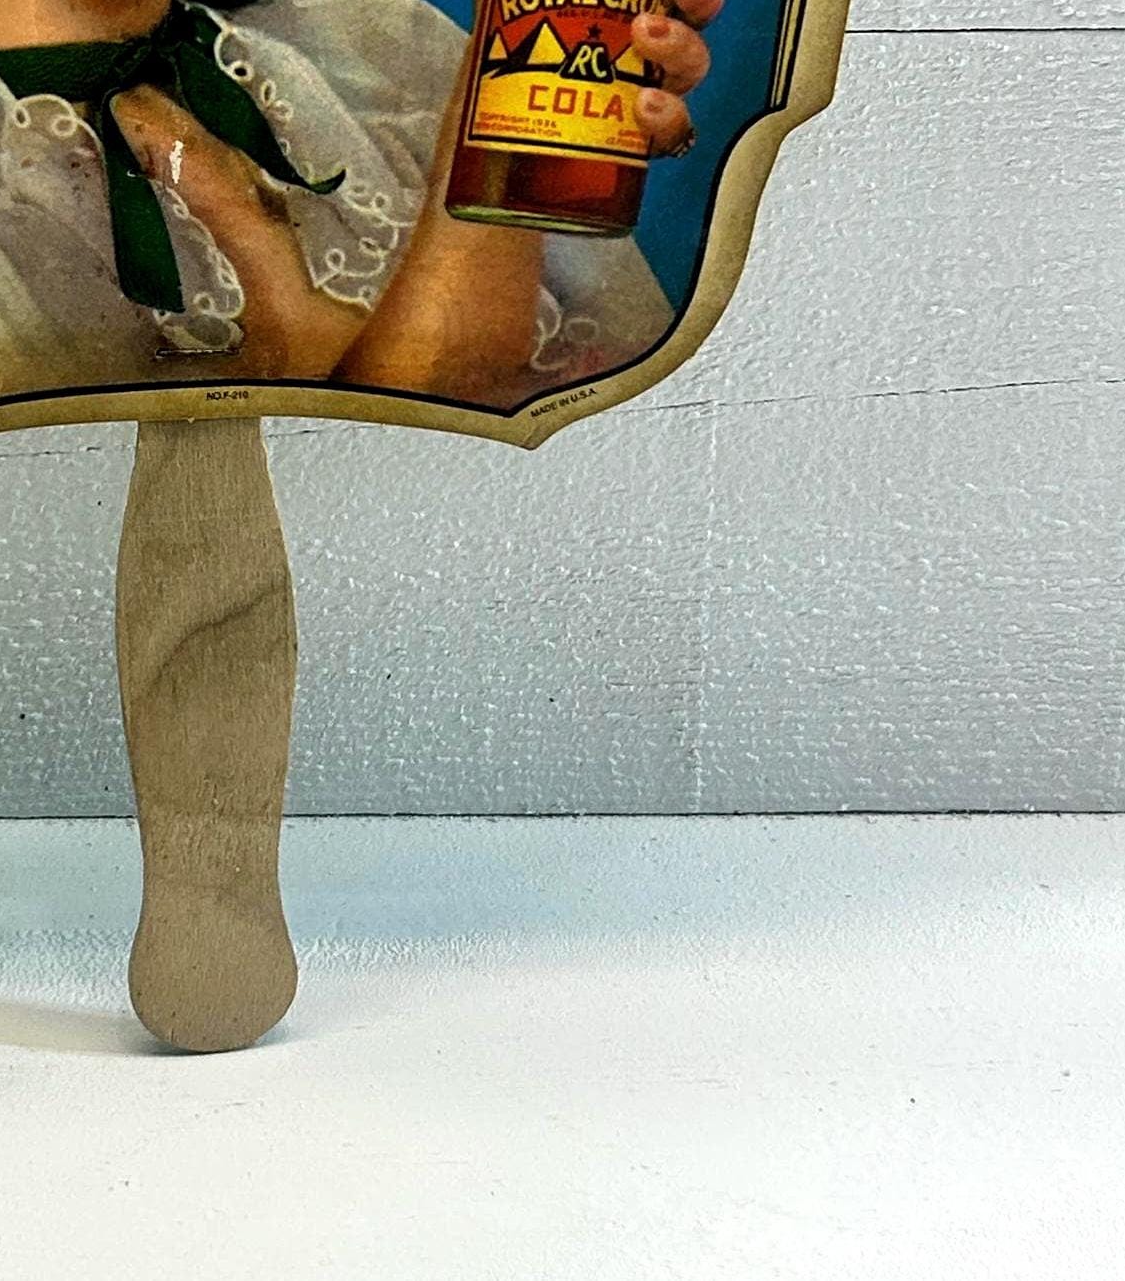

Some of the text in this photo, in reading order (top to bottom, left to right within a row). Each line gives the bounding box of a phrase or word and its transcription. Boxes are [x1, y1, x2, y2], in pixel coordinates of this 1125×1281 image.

[567, 43, 608, 79] RC
[527, 83, 625, 123] COLA
[530, 402, 557, 418] MADE
